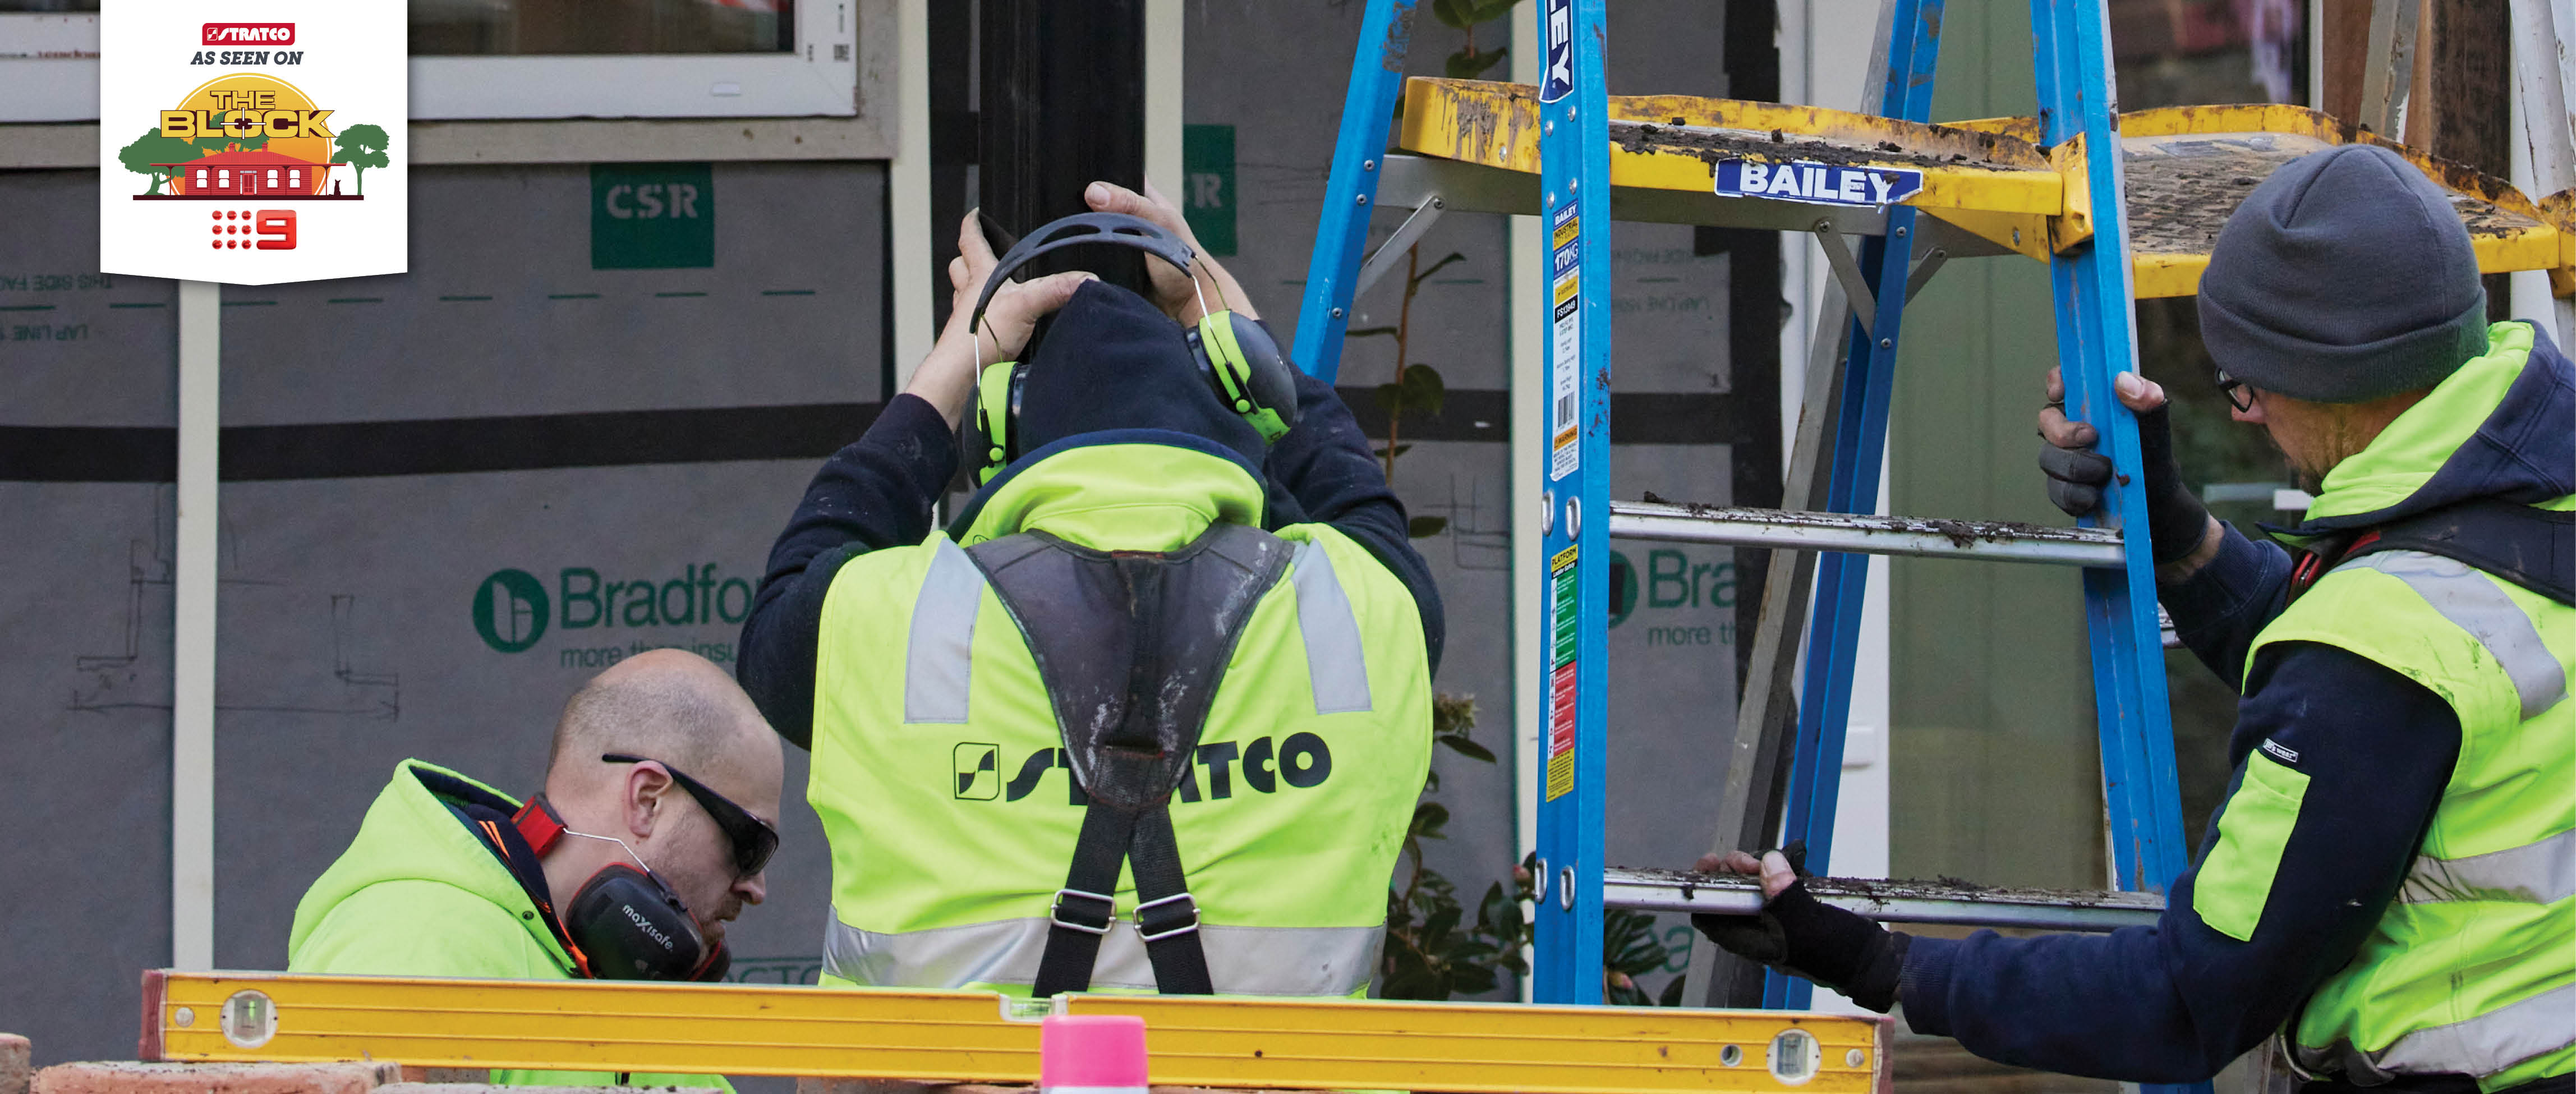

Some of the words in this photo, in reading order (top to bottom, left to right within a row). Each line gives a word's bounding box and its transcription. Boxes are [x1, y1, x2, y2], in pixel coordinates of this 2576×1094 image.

[1740, 163, 1899, 204] BAILEY
[606, 184, 698, 219] CSR
[1554, 204, 1577, 225] BAILEY
[1554, 242, 1579, 272] 170KG
[14, 325, 51, 341] LINE
[56, 323, 88, 341] LAP
[1552, 549, 1576, 566] PLATFORM
[560, 562, 763, 629] Bradfo
[1648, 625, 1711, 645] more
[560, 647, 622, 668] more
[1006, 732, 1332, 806] STCO
